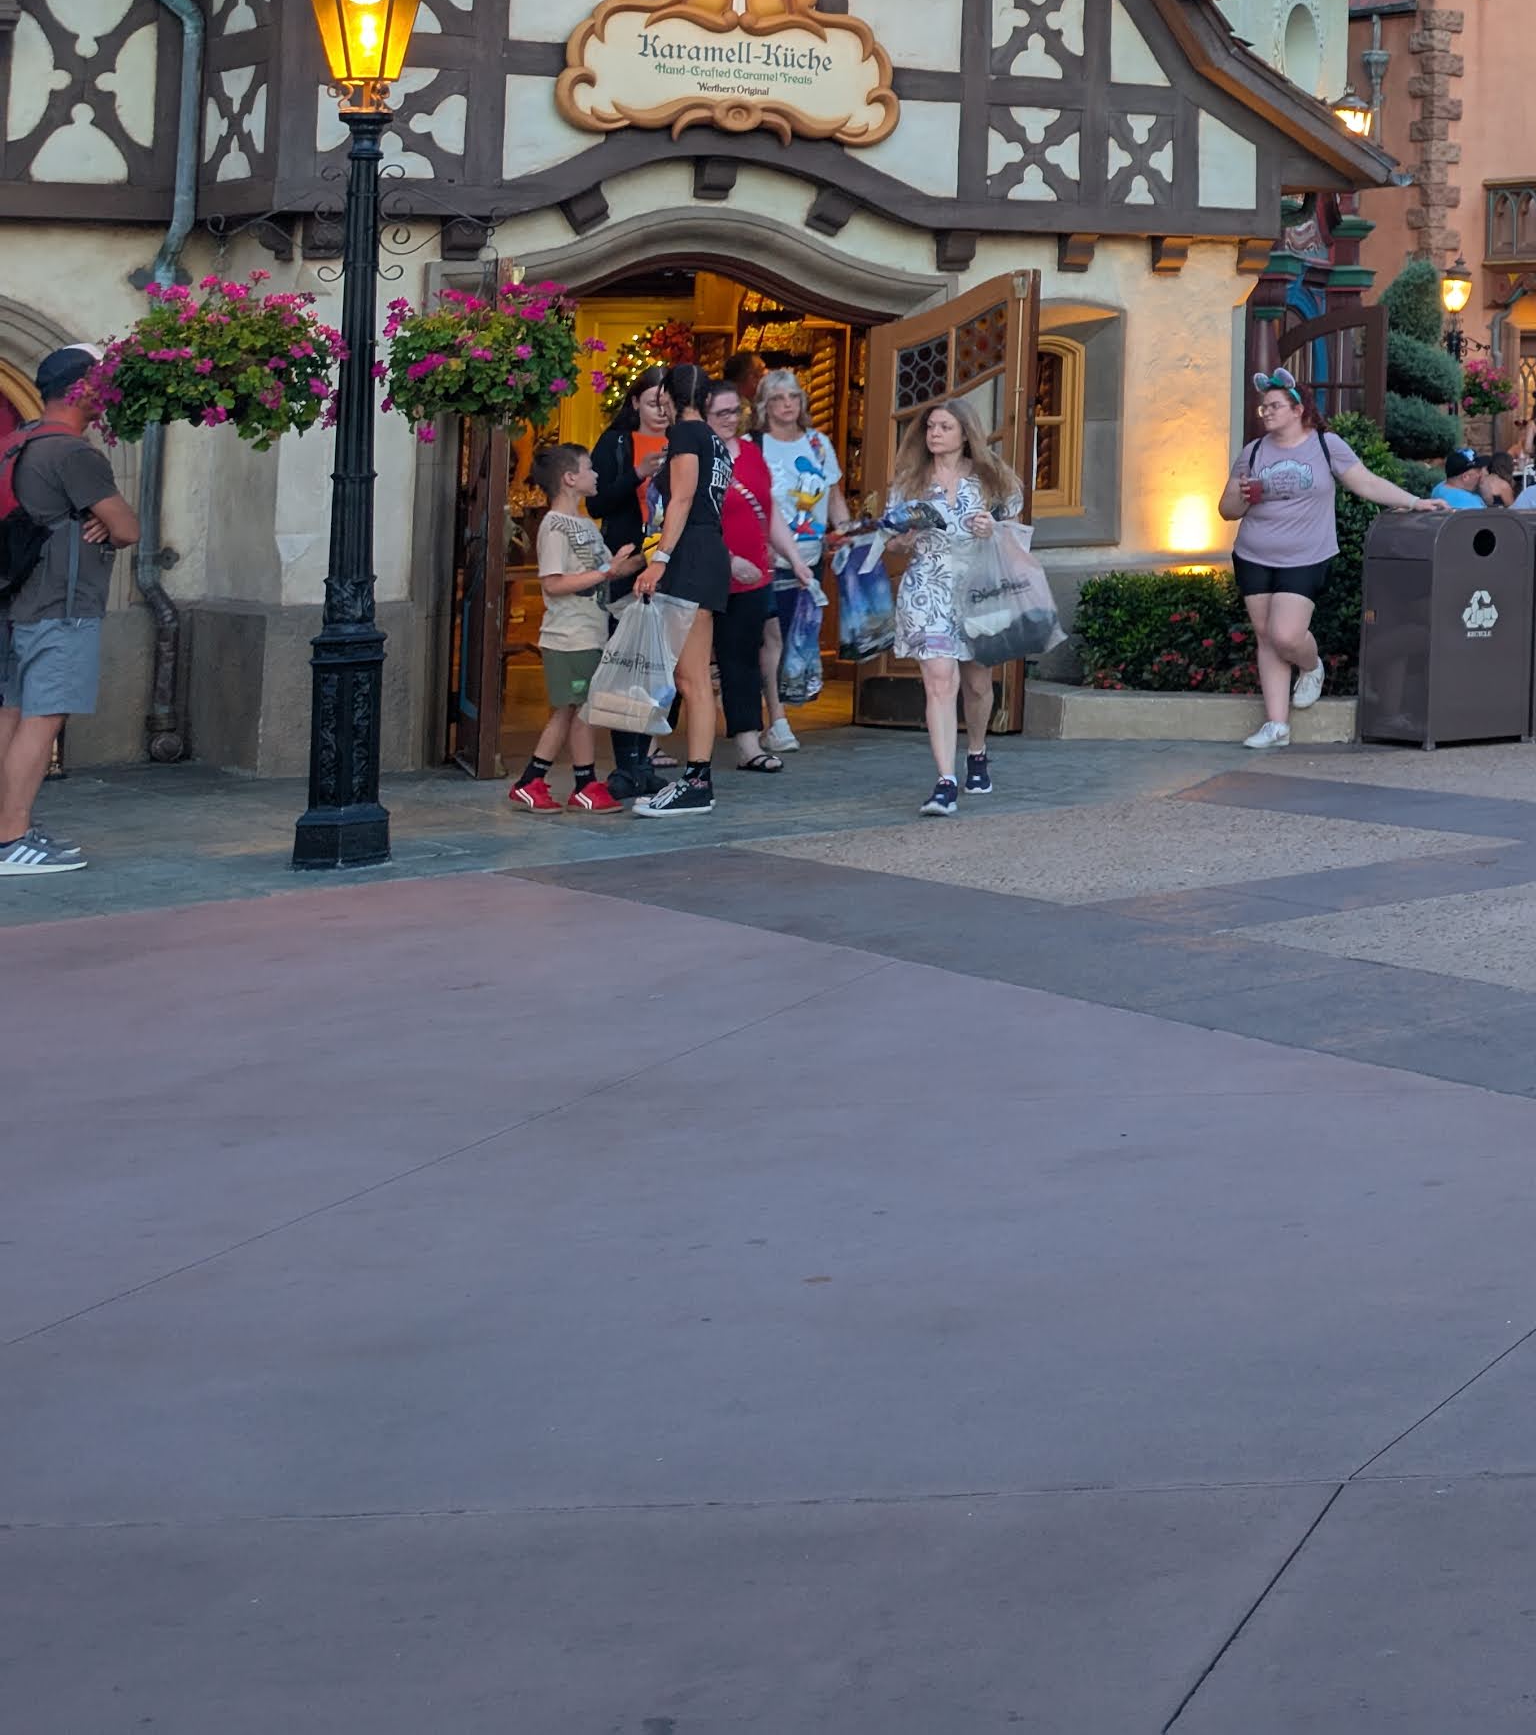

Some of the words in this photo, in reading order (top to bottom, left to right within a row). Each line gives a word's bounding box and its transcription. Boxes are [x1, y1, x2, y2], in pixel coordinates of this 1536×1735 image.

[637, 33, 833, 76] Karamell-Küche
[655, 62, 731, 79] Hand-Crafted
[733, 68, 778, 82] Caramel
[779, 72, 813, 85] Treats
[737, 84, 770, 97] Original
